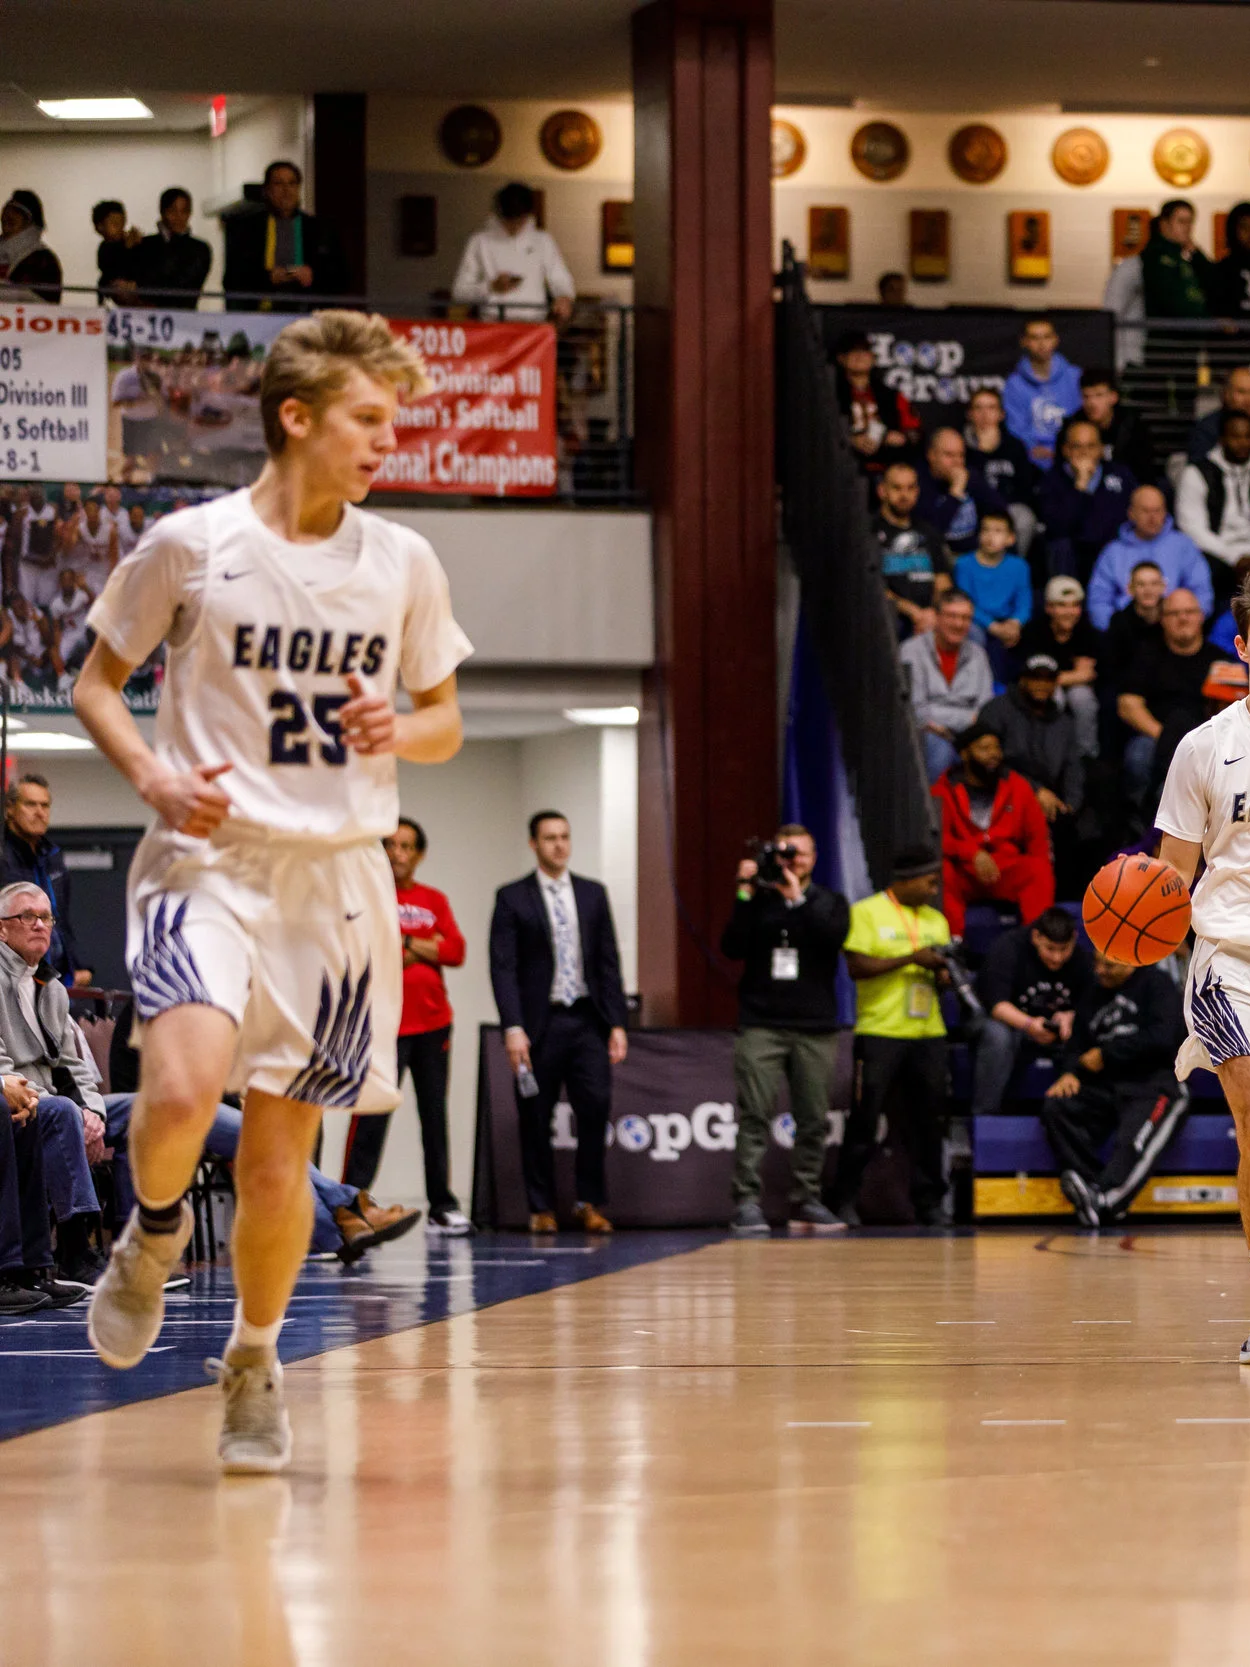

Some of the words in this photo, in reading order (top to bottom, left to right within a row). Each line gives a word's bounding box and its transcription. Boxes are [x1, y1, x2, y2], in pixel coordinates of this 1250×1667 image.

[107, 313, 174, 342] 45-10
[410, 325, 466, 357] 2010
[430, 361, 515, 395] Division
[17, 416, 89, 441] Softball
[456, 399, 539, 431] Softball
[435, 440, 556, 497] Champions
[233, 623, 388, 676] EAGLES
[268, 688, 350, 767] 25
